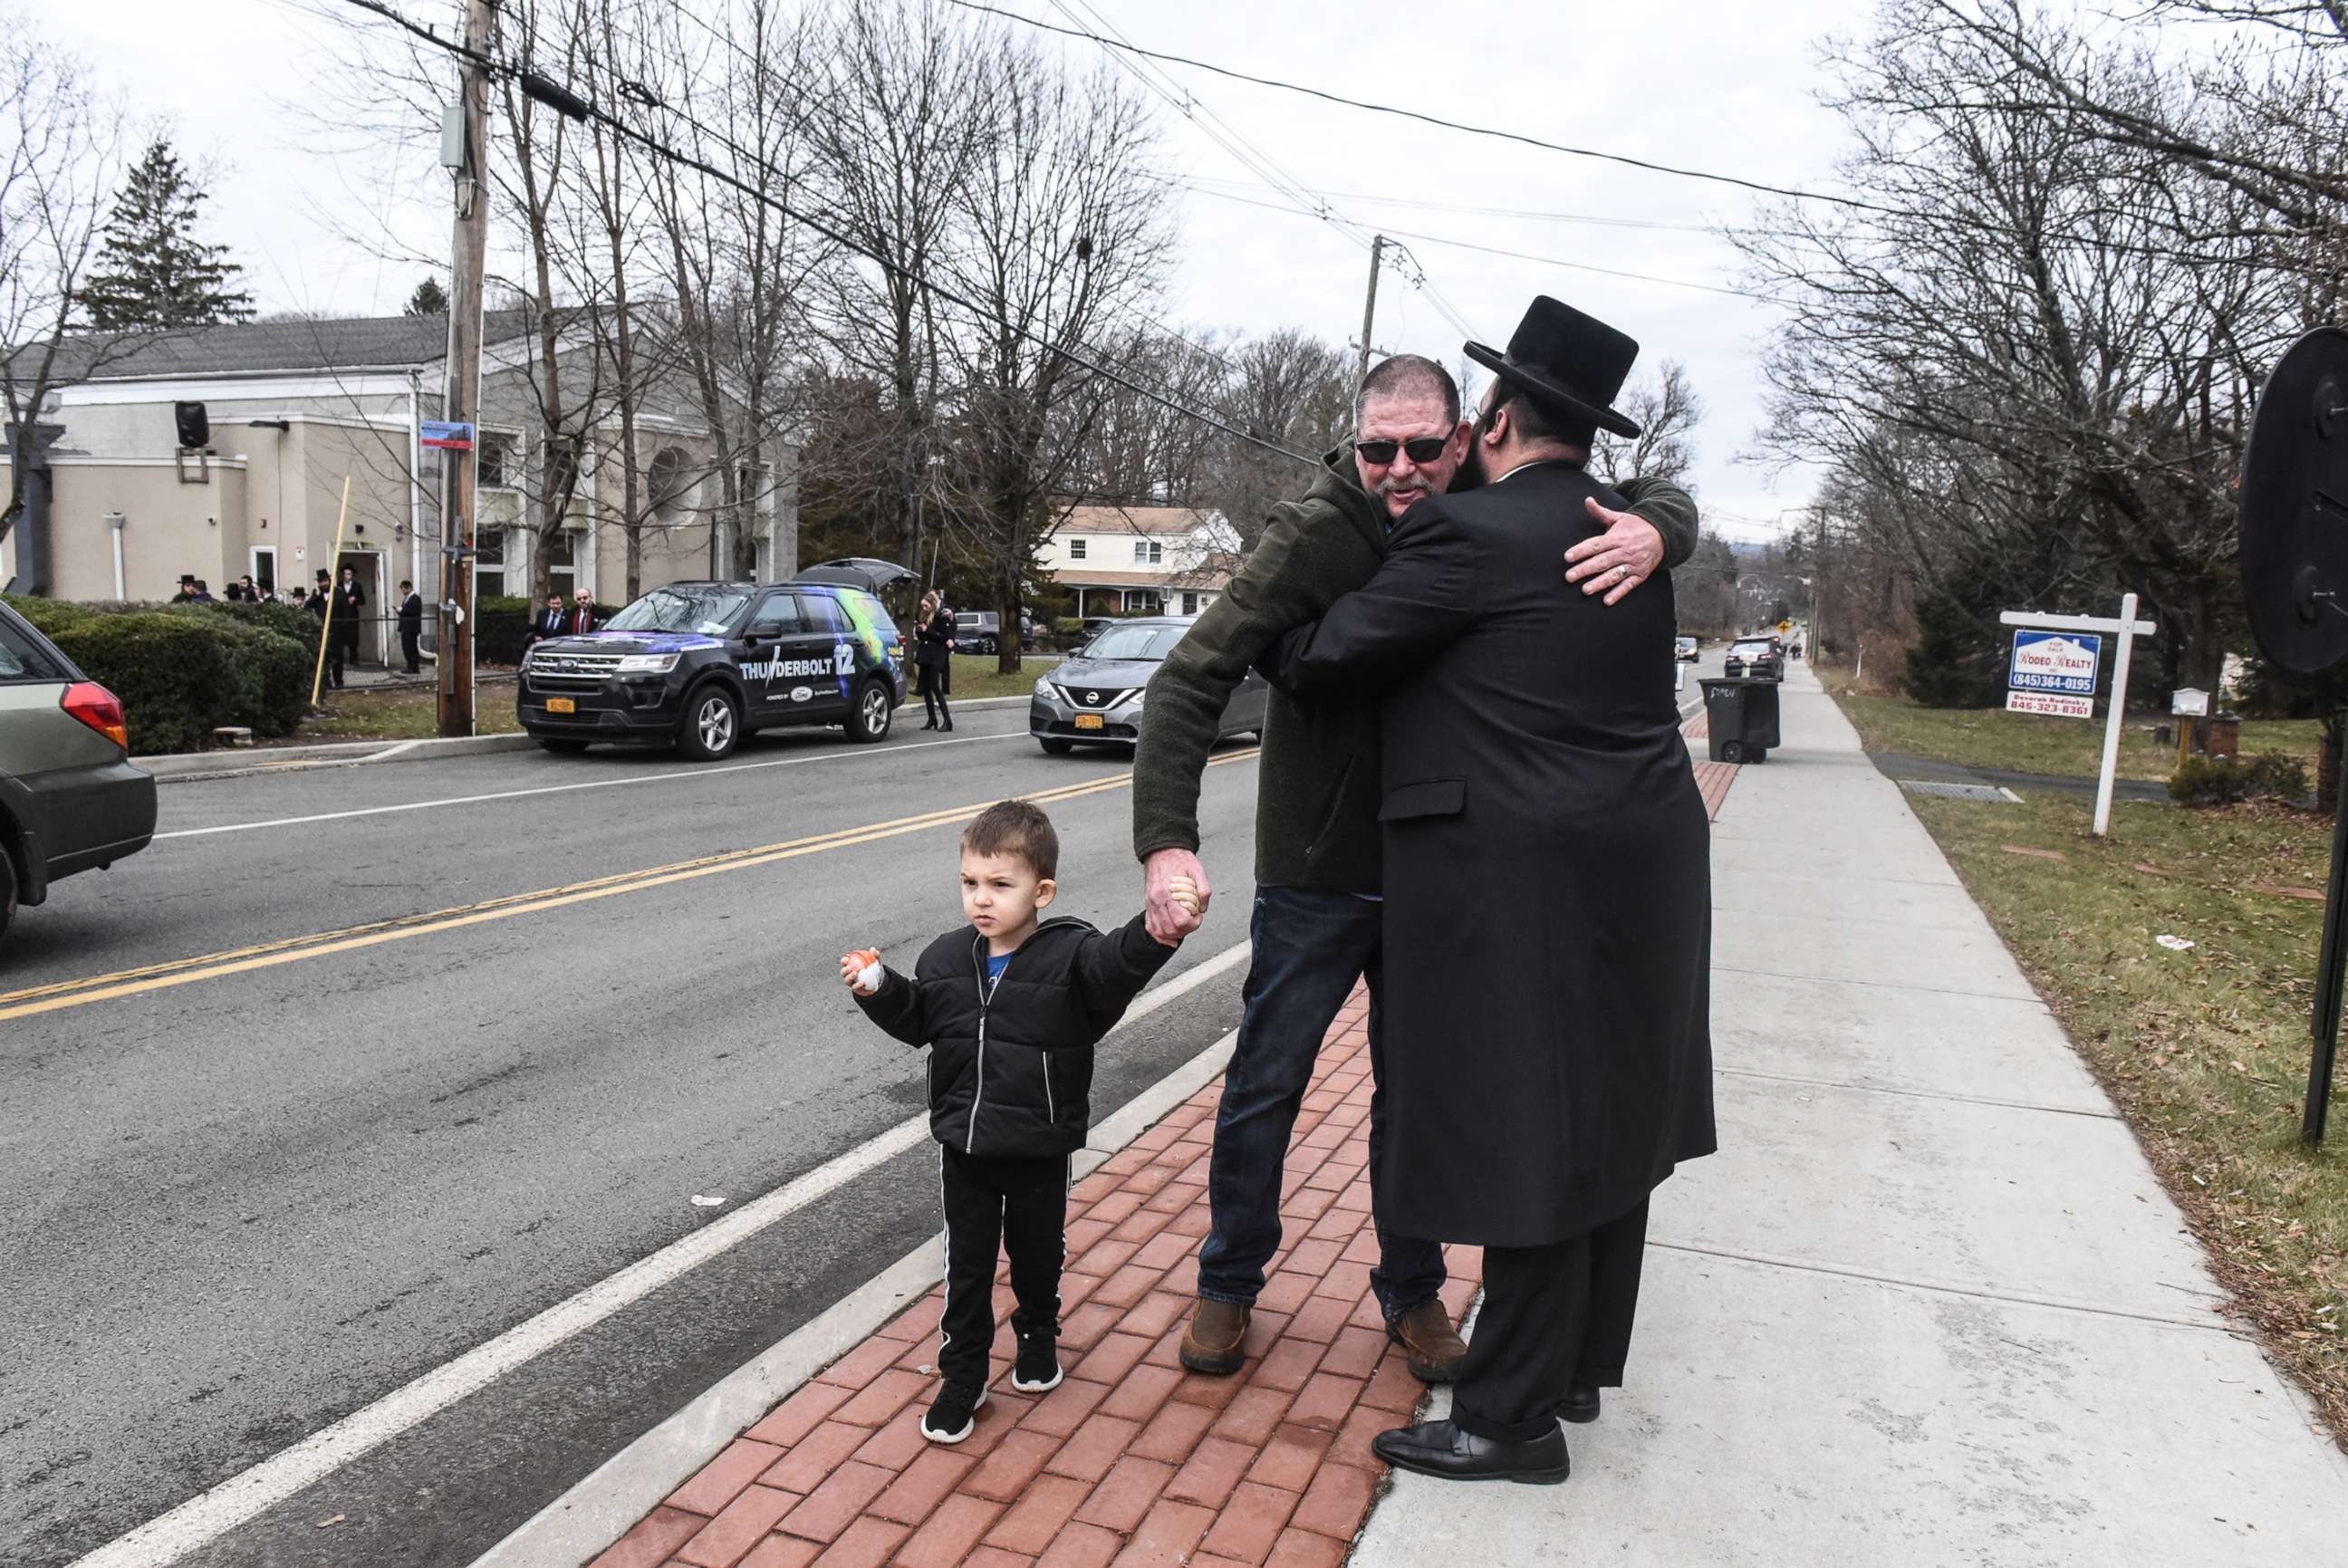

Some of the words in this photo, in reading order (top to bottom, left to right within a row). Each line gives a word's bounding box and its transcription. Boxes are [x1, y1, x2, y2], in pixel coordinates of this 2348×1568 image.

[833, 644, 856, 676] 12
[2018, 652, 2052, 666] RODEO
[2054, 654, 2093, 669] REALTY
[2013, 674, 2091, 690] (845)364-0195
